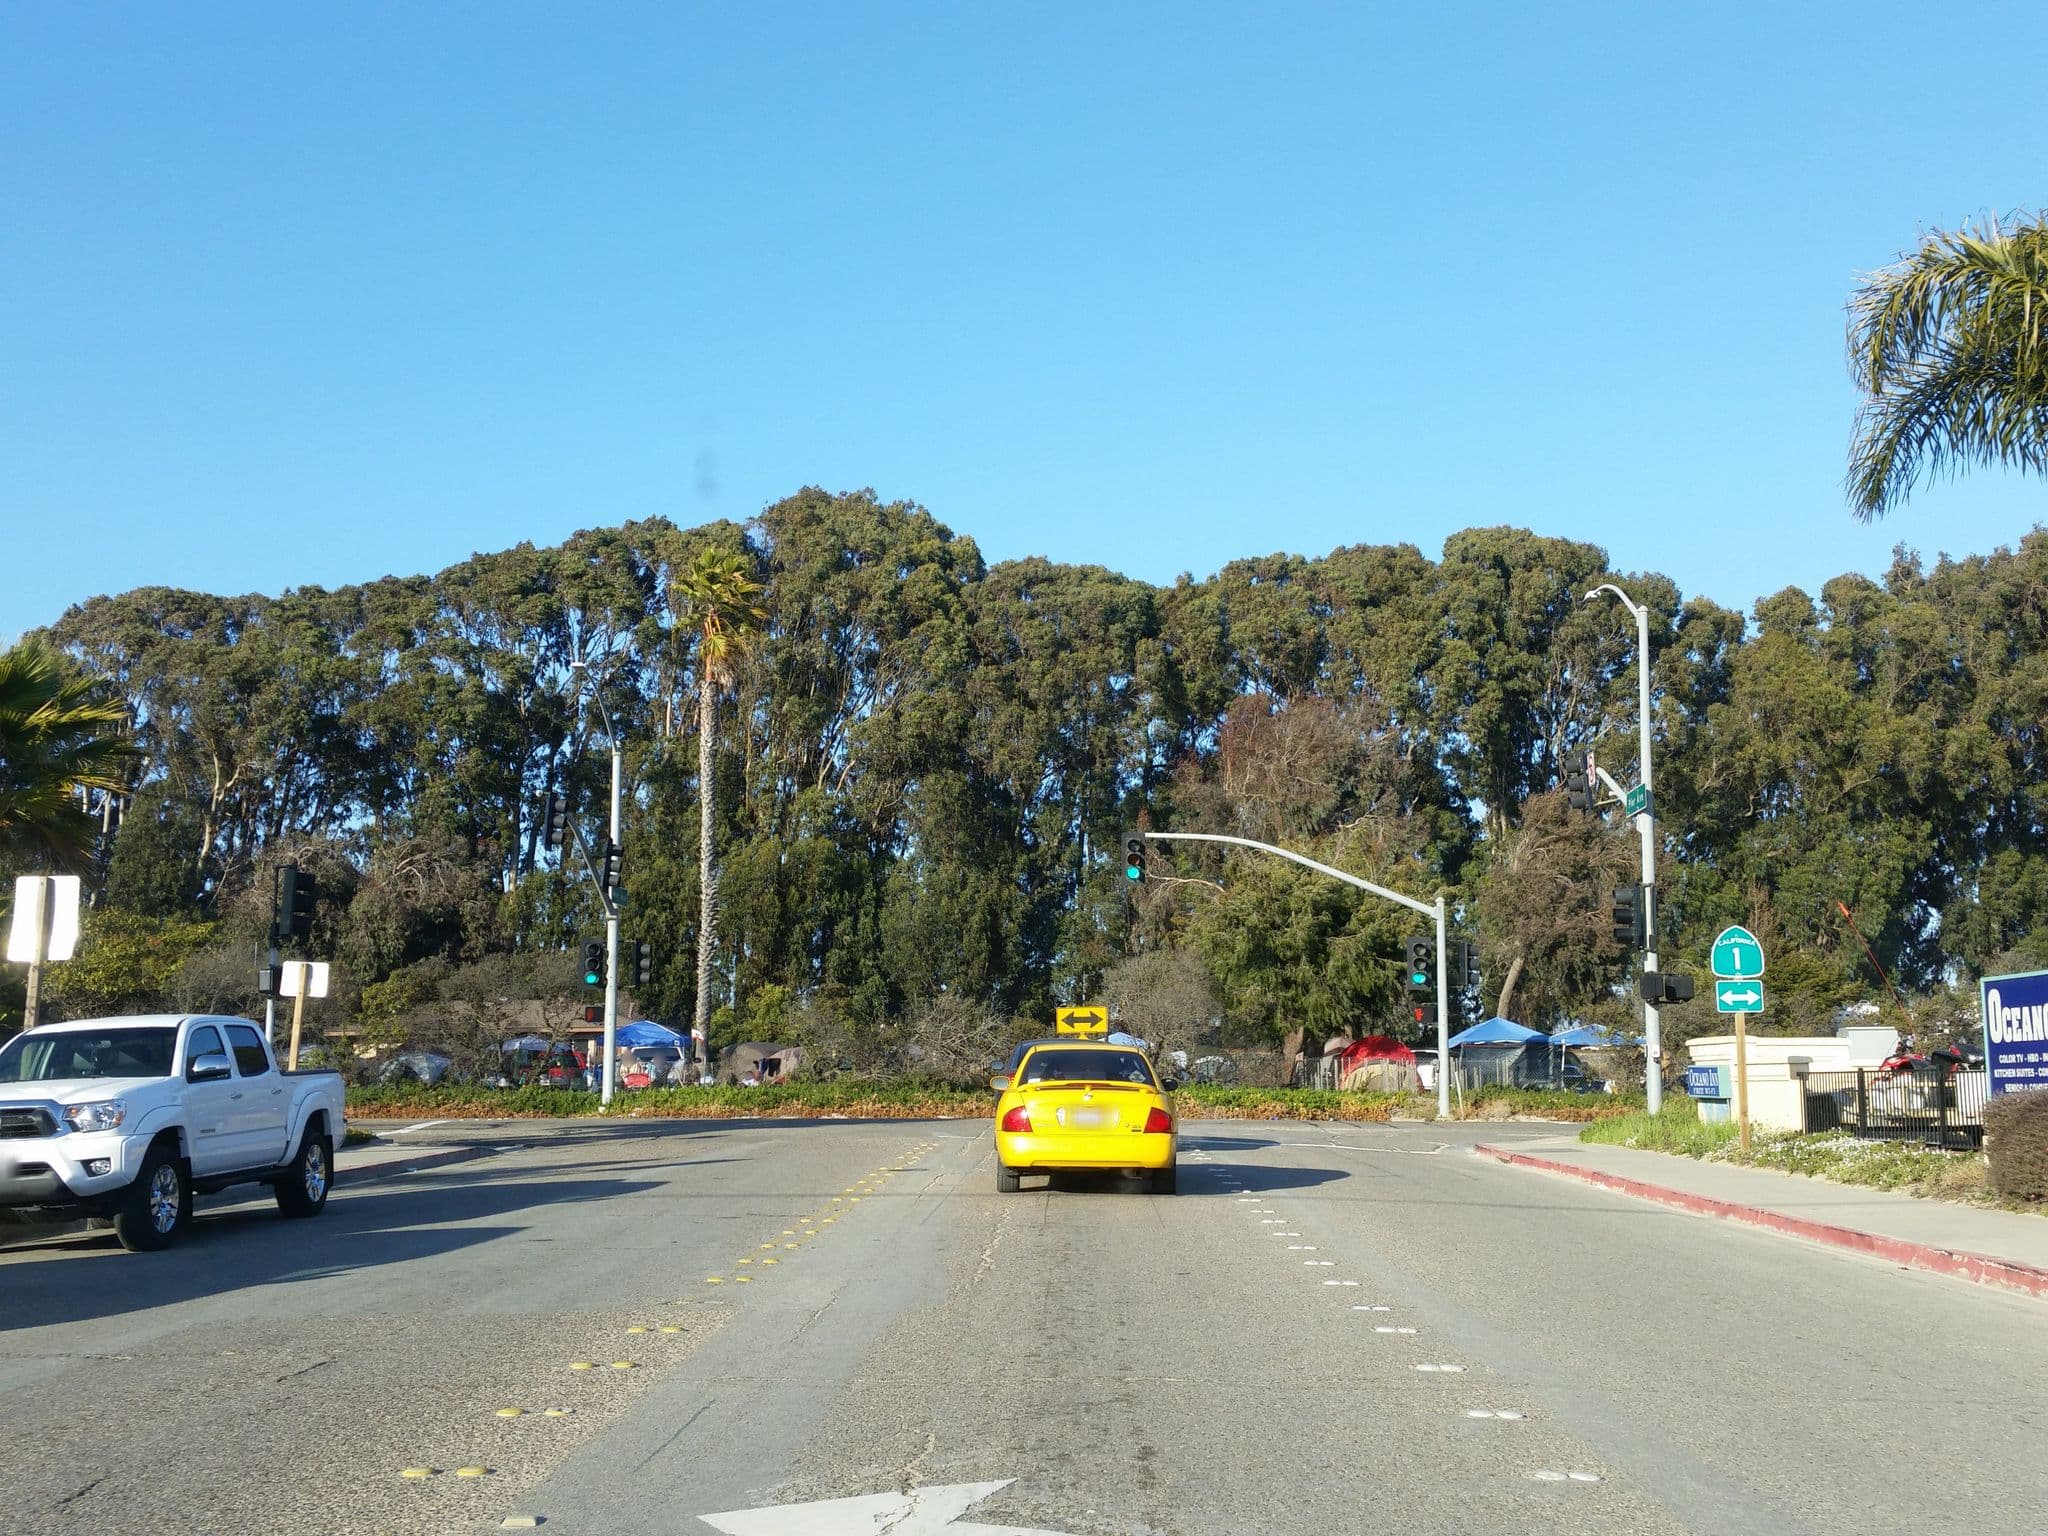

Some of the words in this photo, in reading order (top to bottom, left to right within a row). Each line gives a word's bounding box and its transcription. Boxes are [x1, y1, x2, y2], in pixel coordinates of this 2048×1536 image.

[1718, 938, 1755, 946] CALIFORNIA
[1732, 947, 1741, 970] 1
[1999, 1054, 2016, 1064] COLOR
[2016, 1053, 2024, 1063] TV
[1689, 1069, 1709, 1086] OCEANO
